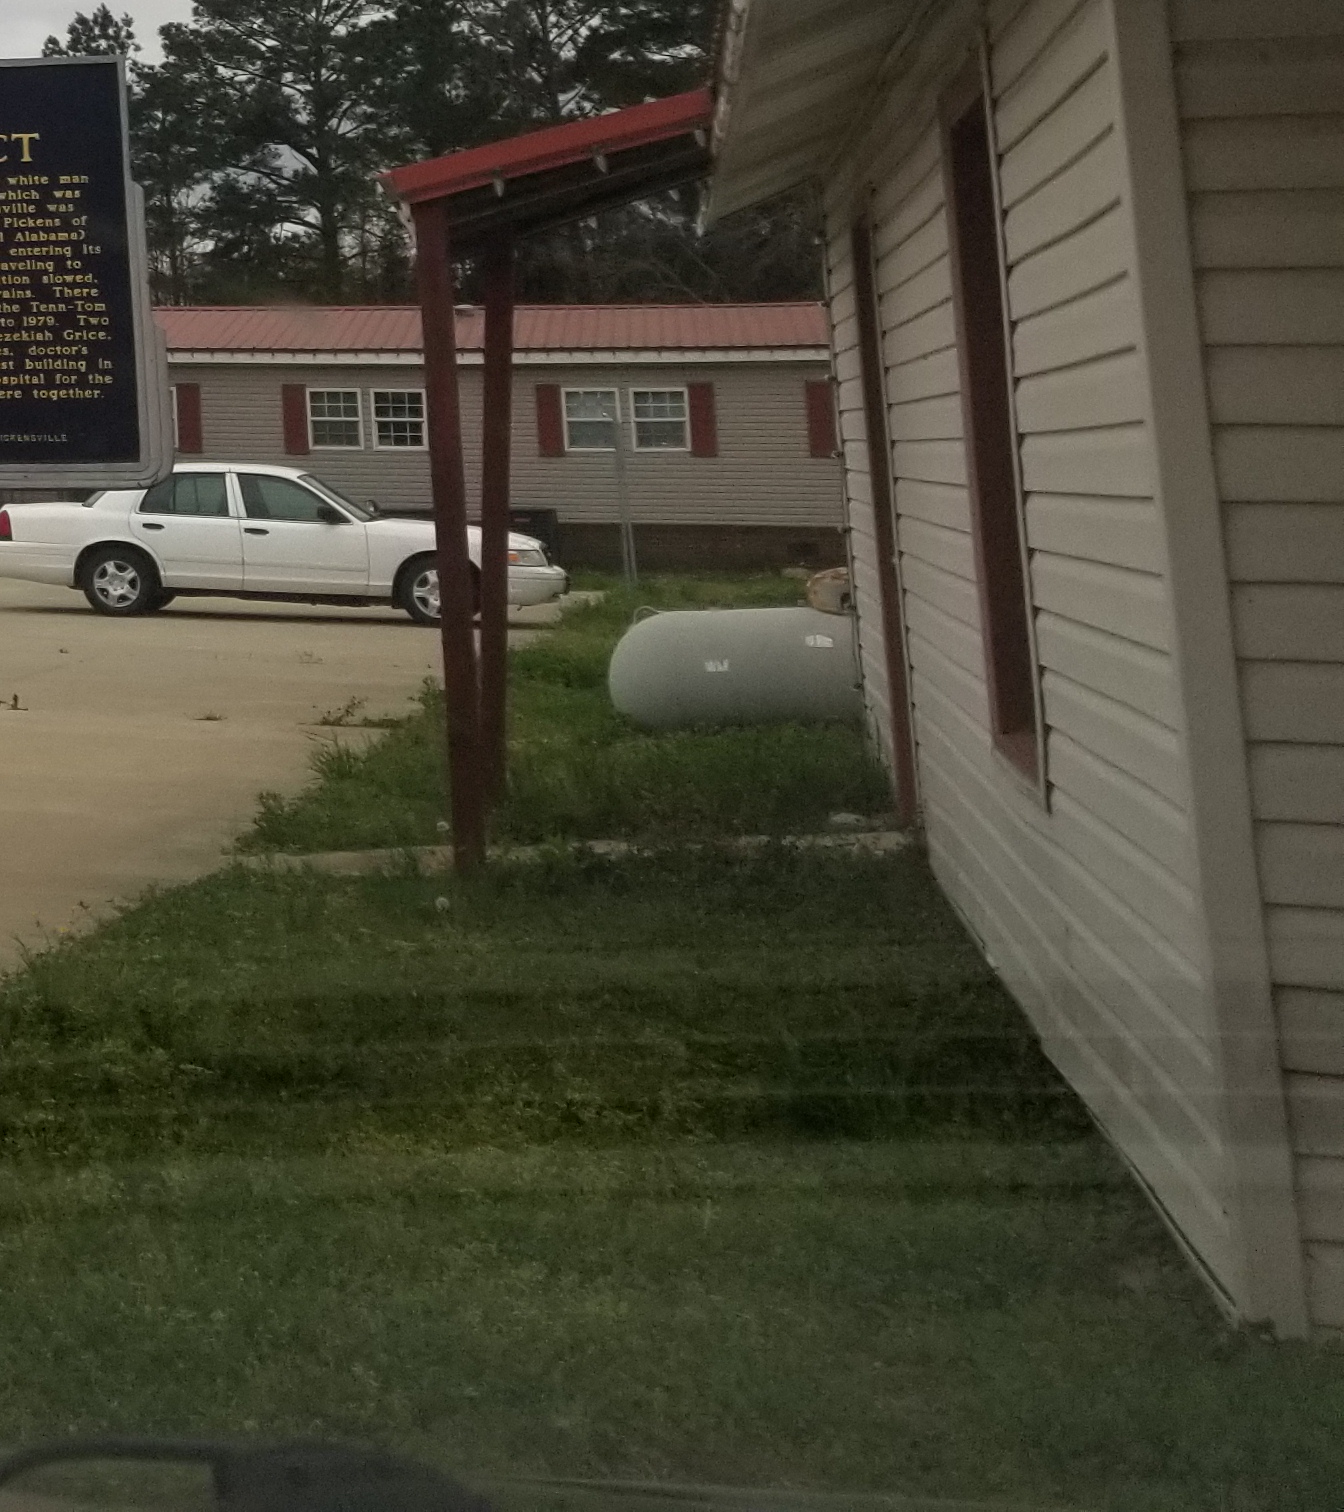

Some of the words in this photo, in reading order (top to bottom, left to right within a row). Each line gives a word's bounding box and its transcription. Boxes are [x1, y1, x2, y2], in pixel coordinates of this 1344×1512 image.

[6, 174, 48, 186] white
[58, 175, 88, 184] man
[52, 189, 80, 198] was
[46, 204, 74, 212] was
[4, 216, 60, 228] Pickens
[72, 215, 88, 226] of
[8, 244, 72, 257] entering
[56, 286, 98, 297] There
[80, 315, 110, 326] Two
[26, 358, 86, 371] building
[54, 373, 78, 384] for
[88, 372, 112, 383] the
